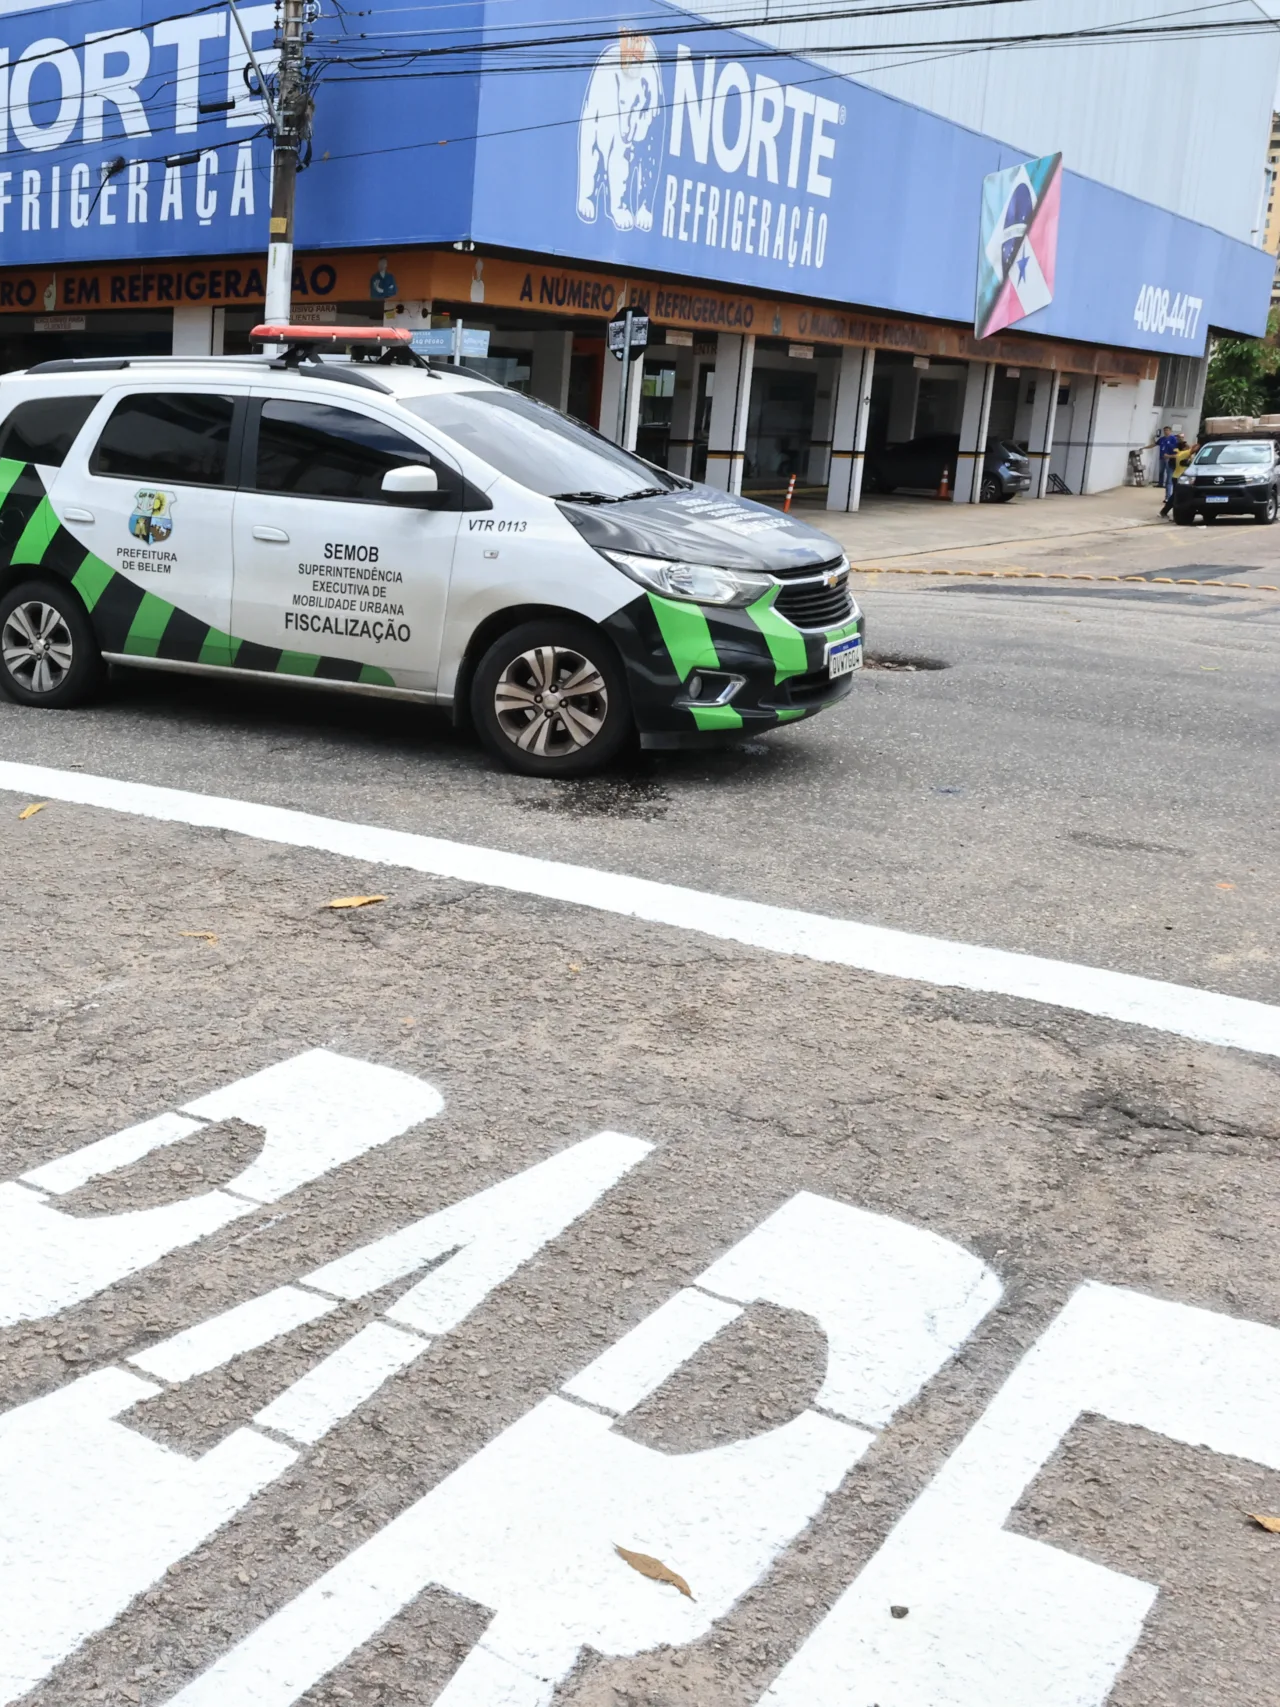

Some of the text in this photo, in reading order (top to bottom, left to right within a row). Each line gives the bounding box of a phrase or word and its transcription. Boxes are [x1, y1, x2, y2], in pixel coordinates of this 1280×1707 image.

[669, 44, 841, 198] NORTE
[662, 175, 828, 269] REFRIGERAÇÃO
[63, 276, 100, 304] EM
[110, 262, 337, 303] REFRIGERAÃO
[520, 273, 533, 303] A
[540, 271, 615, 312] NÚMERO
[1133, 283, 1203, 340] 4008-4477
[469, 519, 528, 533] VTR 0113
[117, 547, 178, 562] PREFEITURA
[323, 542, 379, 563] SEMOB
[122, 560, 135, 570] DE
[298, 562, 403, 584] SUPERINTENDÊNCIA
[312, 580, 387, 598] EXECUTIVA DE
[292, 594, 405, 616] MOBILIDADE URBANA
[285, 612, 411, 644] FISCALIZAÇÃO
